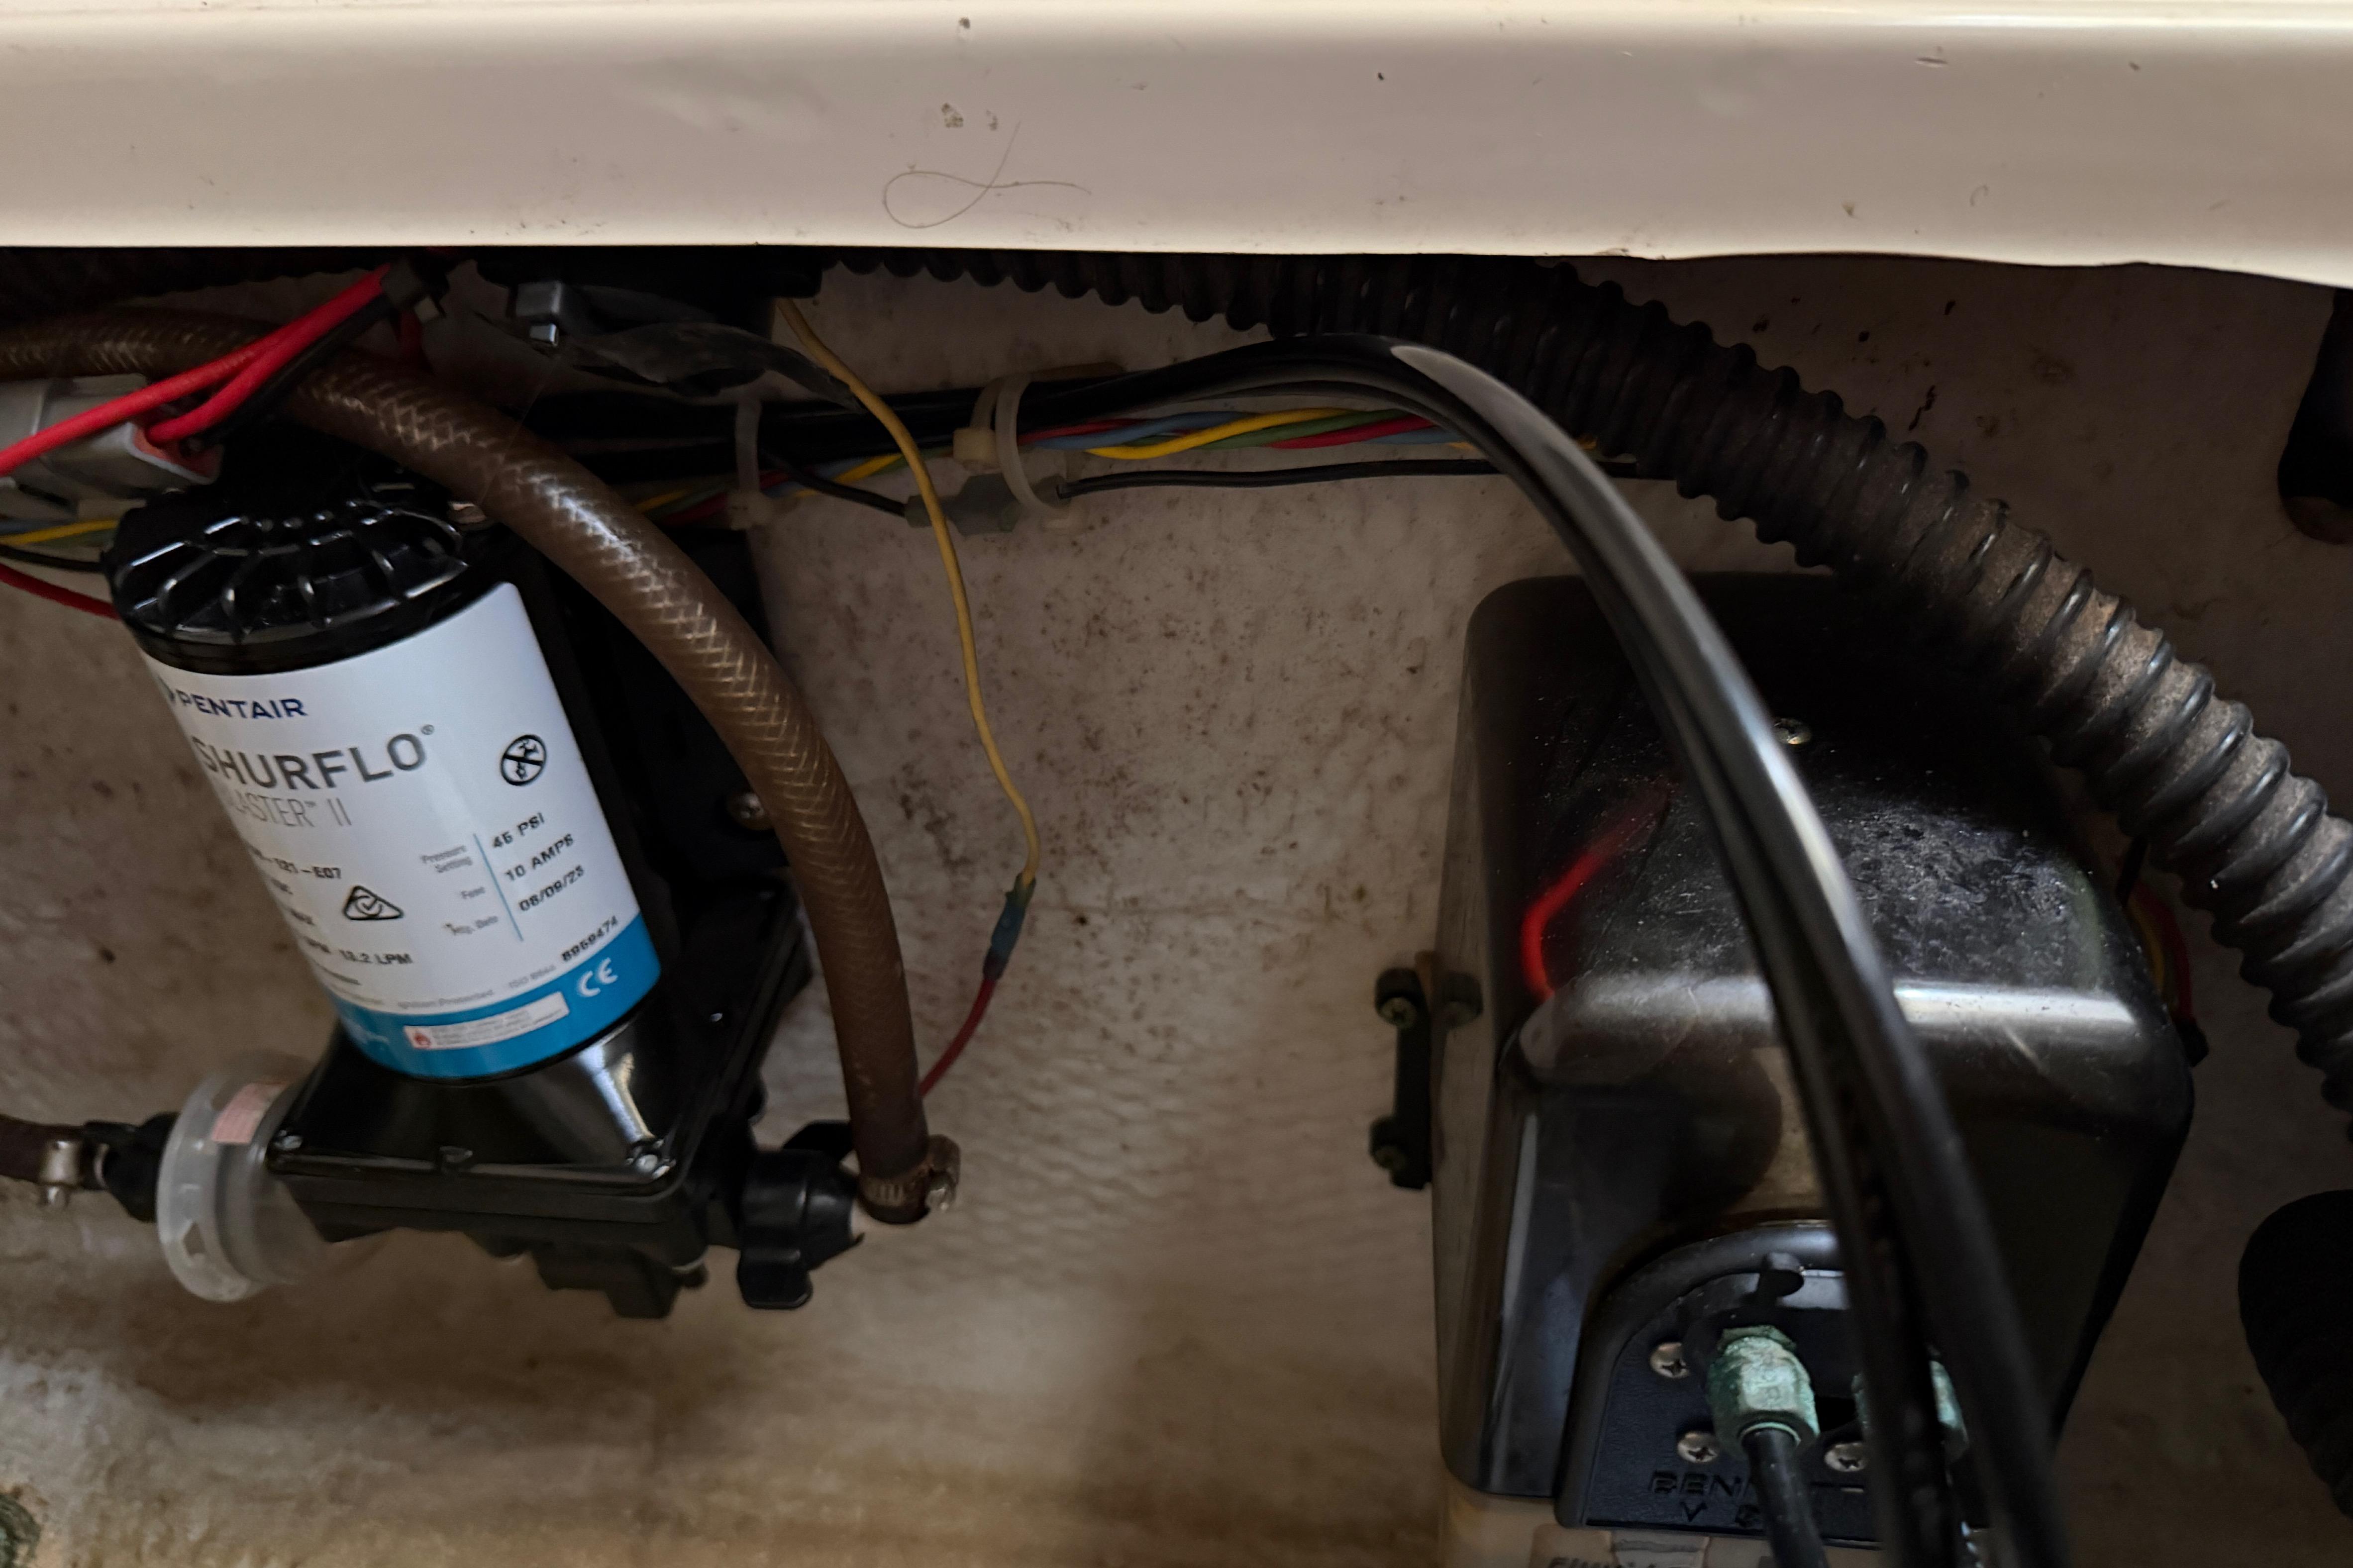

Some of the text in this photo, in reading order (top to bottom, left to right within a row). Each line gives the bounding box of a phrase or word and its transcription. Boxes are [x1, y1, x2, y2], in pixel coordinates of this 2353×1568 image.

[176, 689, 307, 719] PENTAIR
[492, 811, 545, 849] 45 PSI
[504, 833, 575, 882] 10 AMPS
